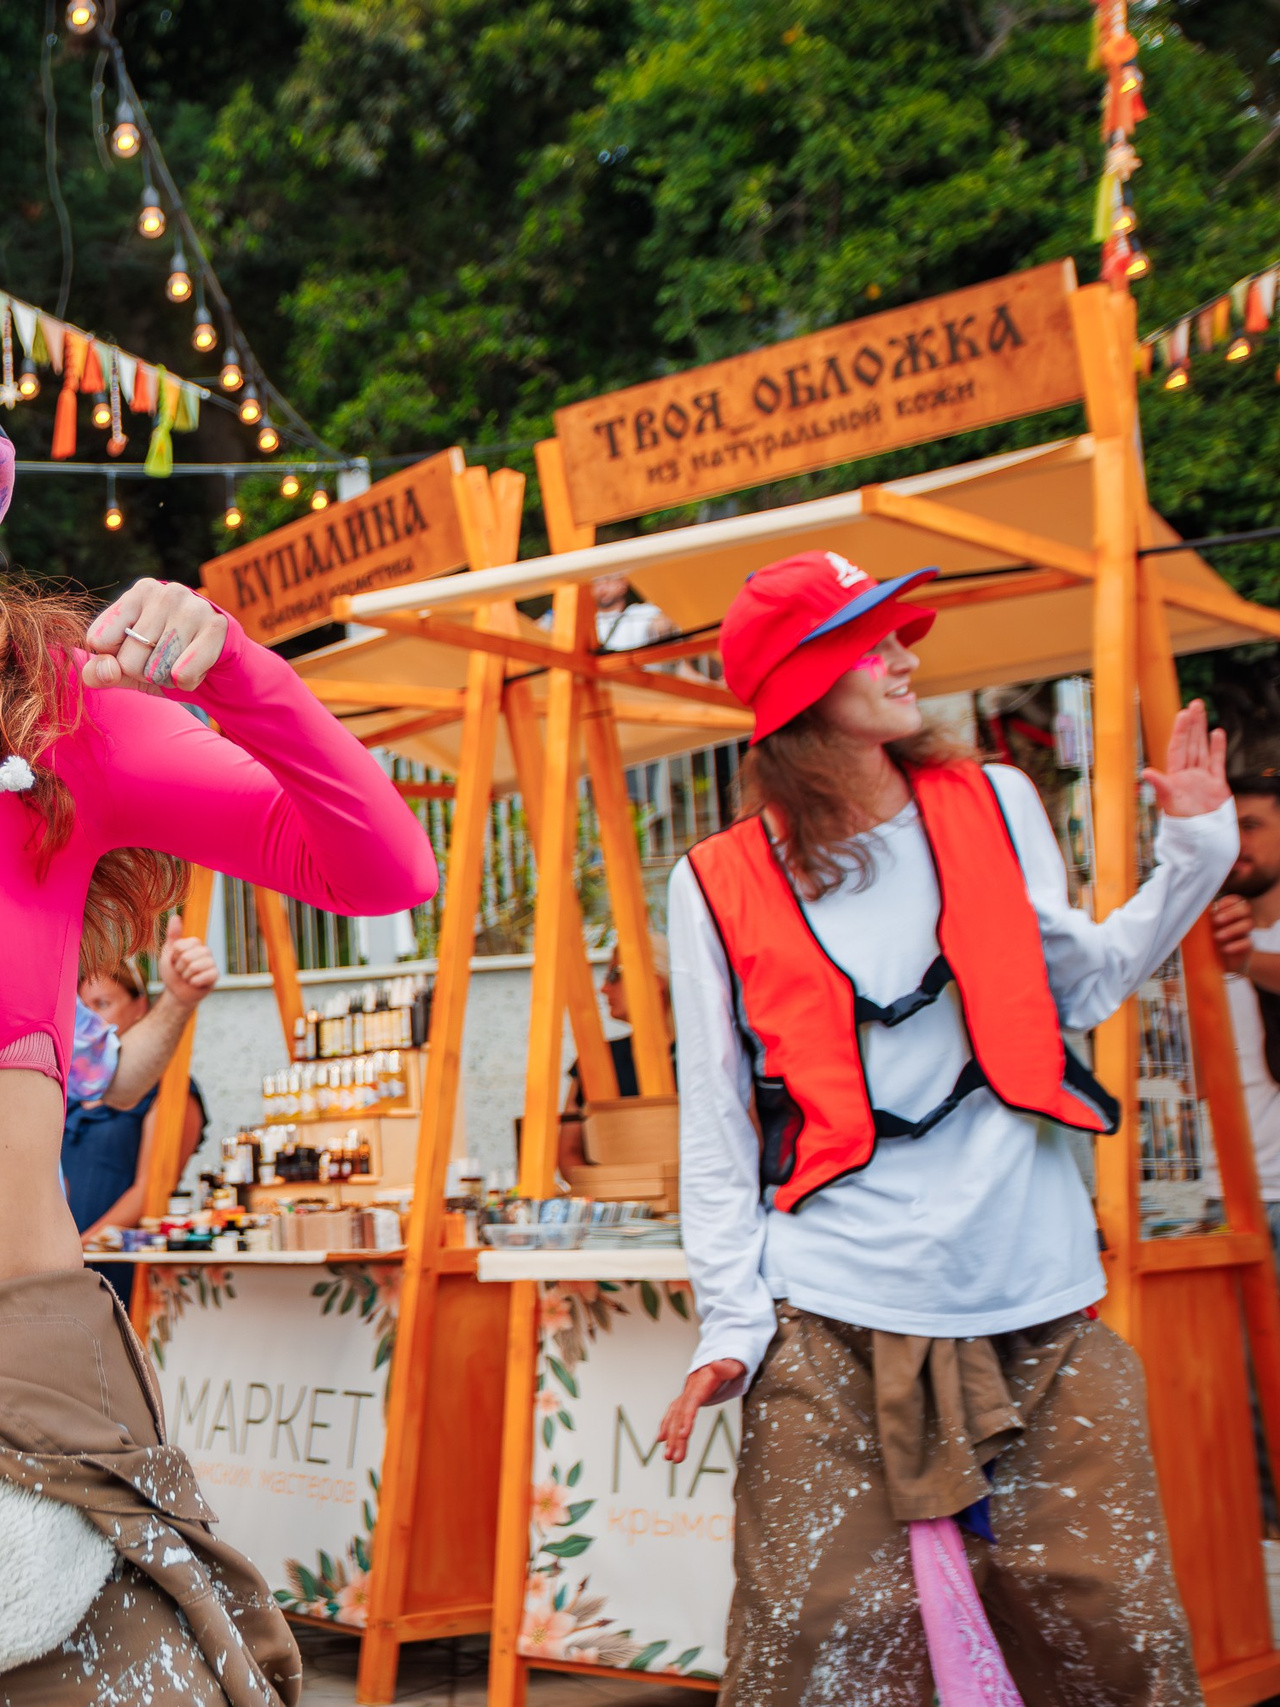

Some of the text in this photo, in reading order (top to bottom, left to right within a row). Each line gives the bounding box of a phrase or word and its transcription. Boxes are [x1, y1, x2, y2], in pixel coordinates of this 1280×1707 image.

[231, 486, 429, 609] КУПАЛИНА
[171, 1376, 376, 1469] МАРКЕТ
[611, 1403, 738, 1499] МА
[260, 1467, 358, 1510] мастеров
[607, 1504, 736, 1547] крымс
